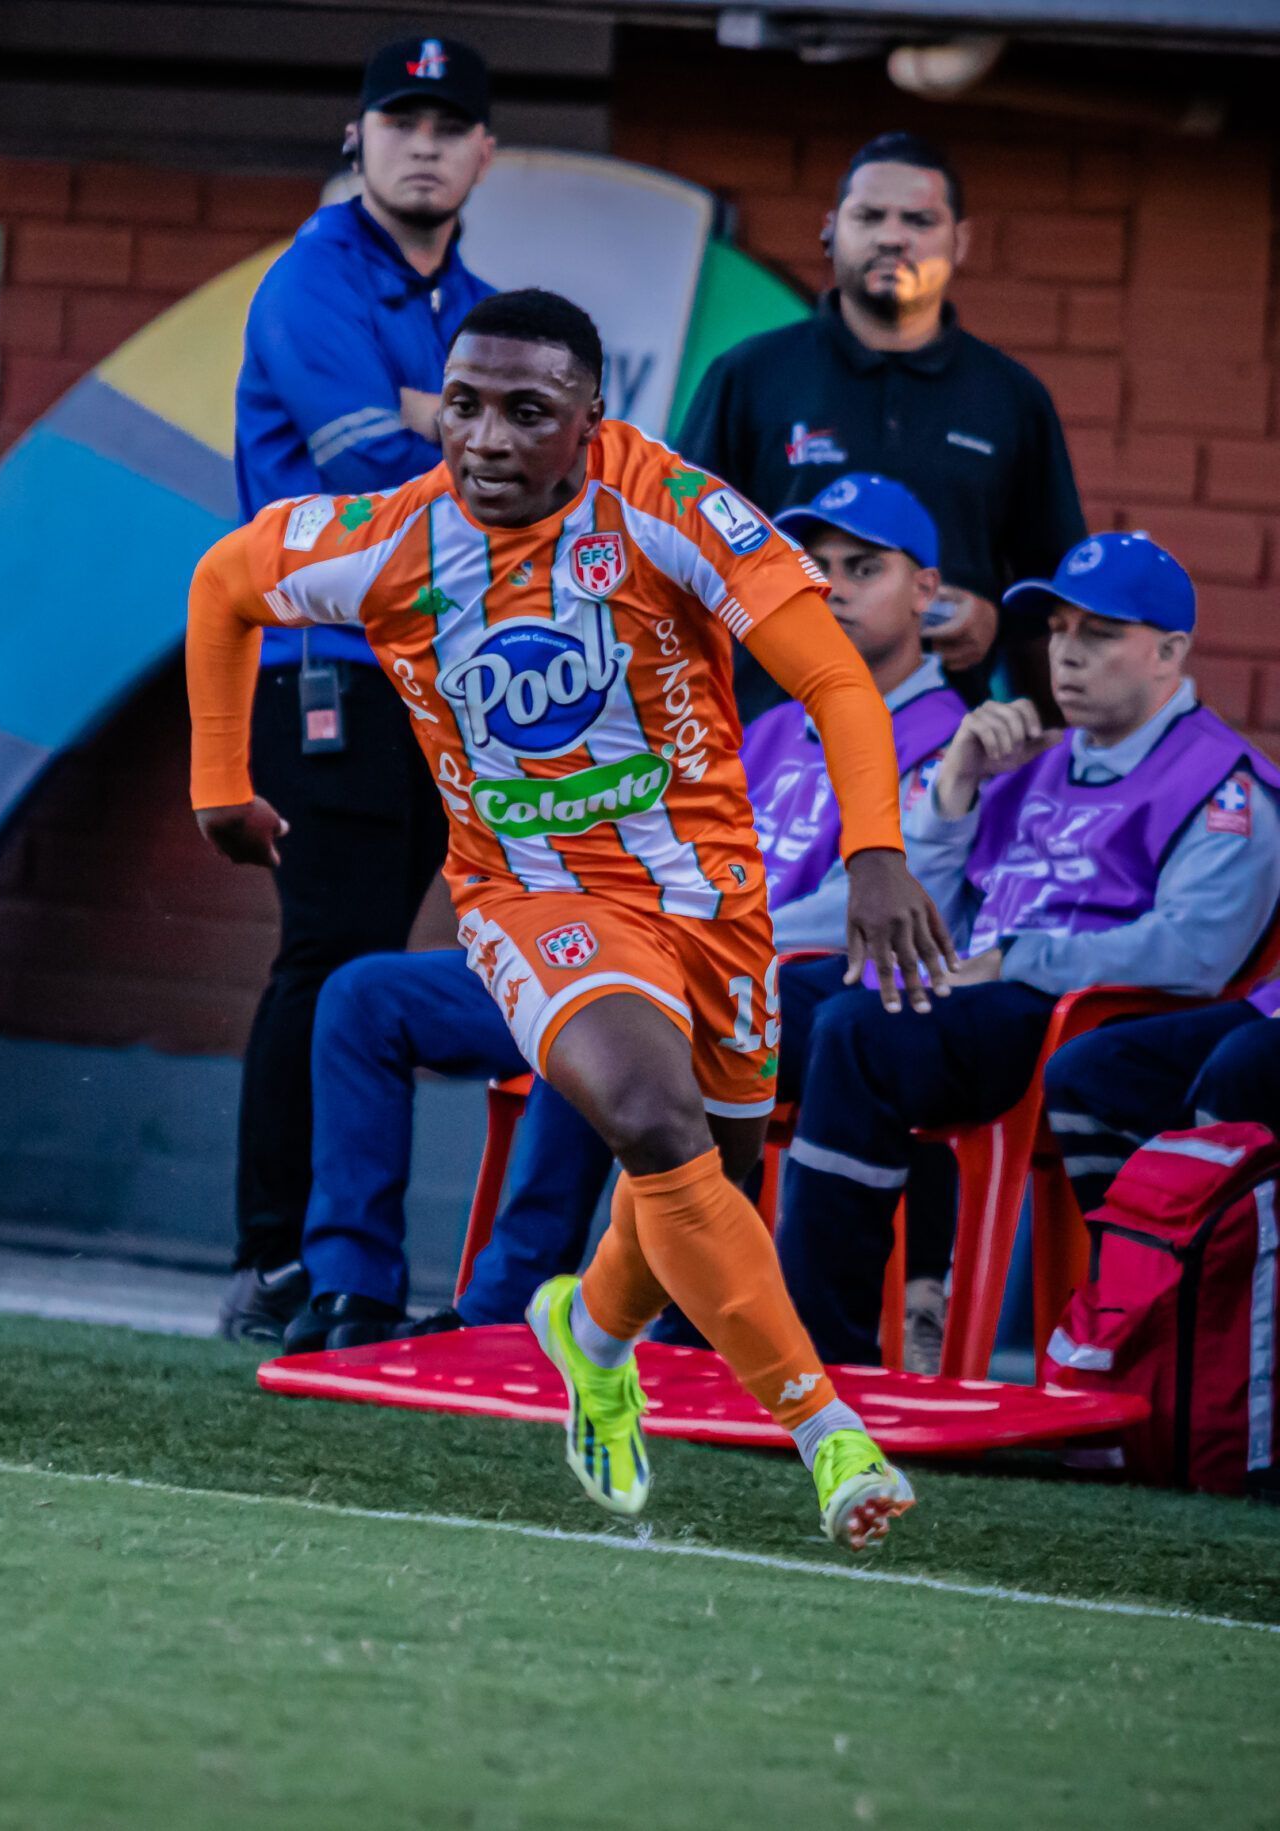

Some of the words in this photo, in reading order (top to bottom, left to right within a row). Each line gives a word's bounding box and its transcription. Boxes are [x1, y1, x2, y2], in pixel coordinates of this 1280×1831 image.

[580, 547, 615, 565] EFC
[440, 601, 620, 748] Pool
[474, 766, 663, 825] Colanta
[549, 932, 585, 953] EFC
